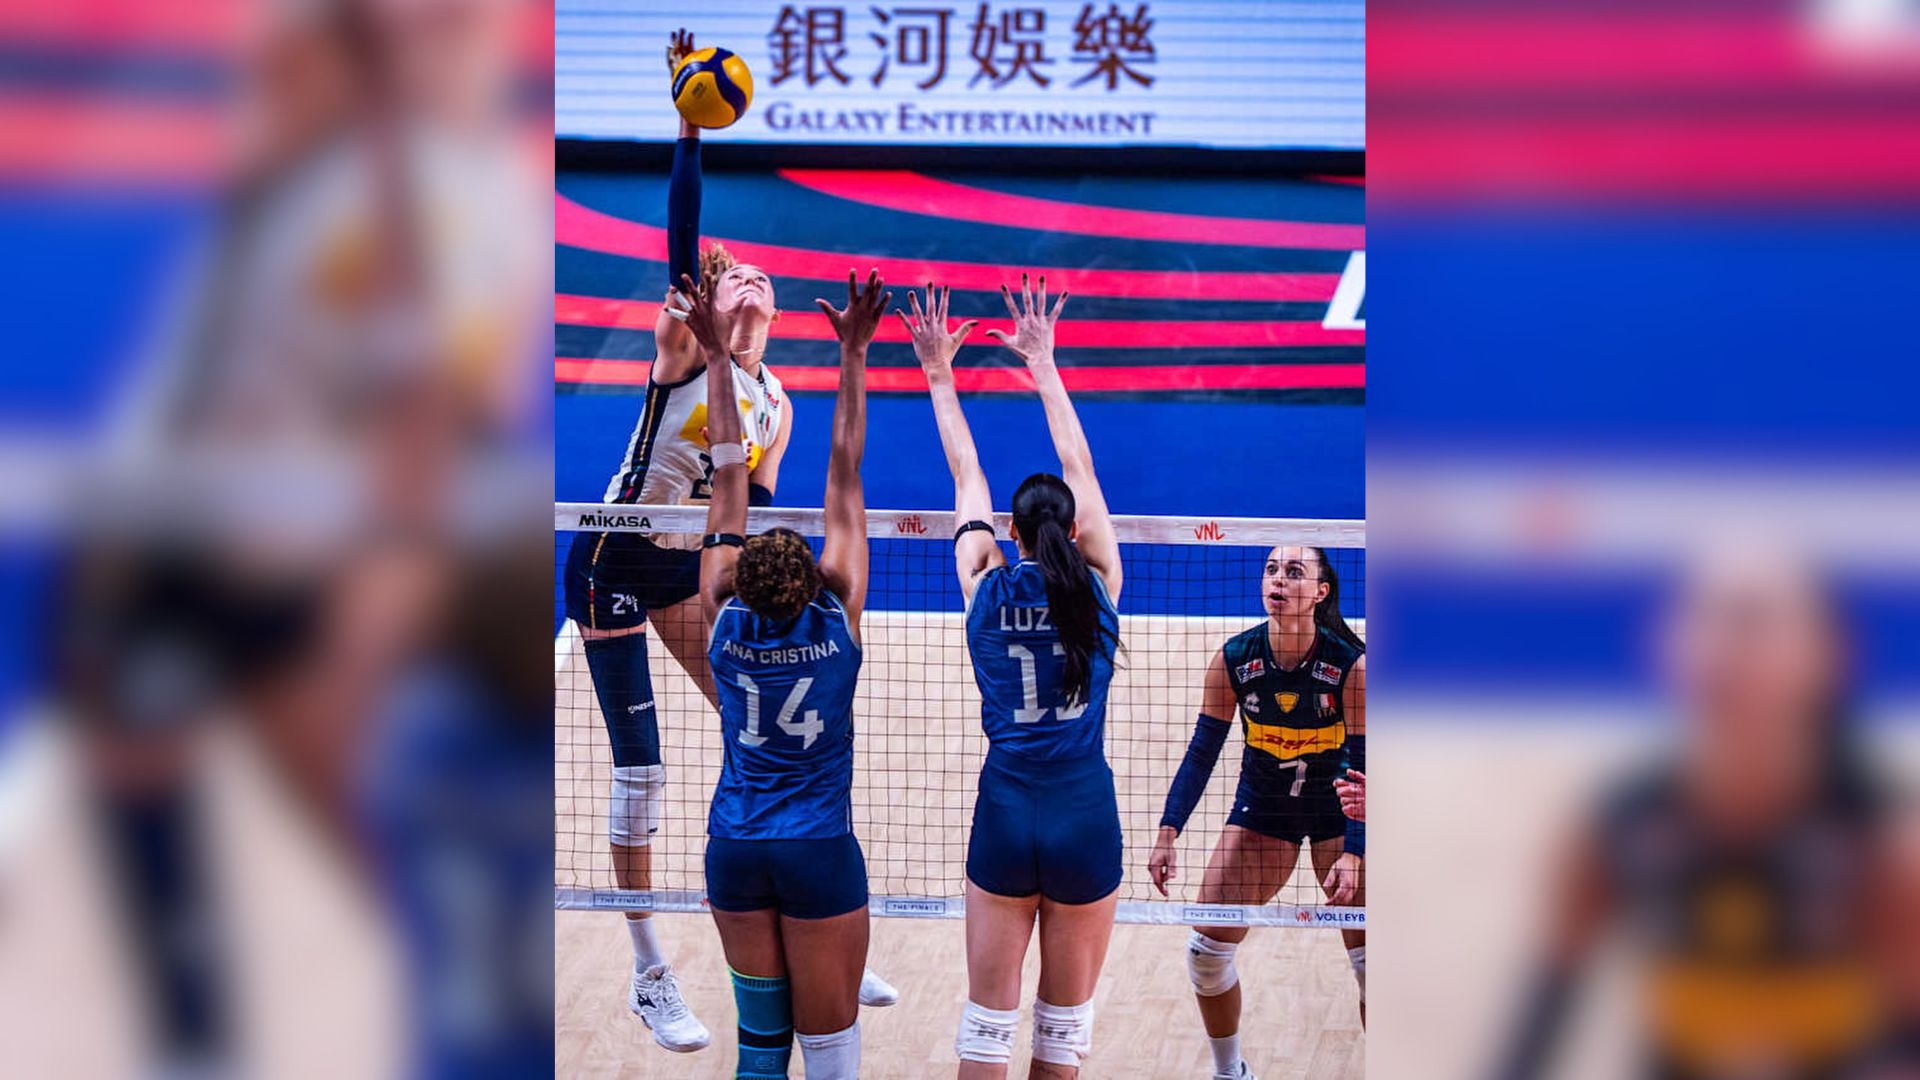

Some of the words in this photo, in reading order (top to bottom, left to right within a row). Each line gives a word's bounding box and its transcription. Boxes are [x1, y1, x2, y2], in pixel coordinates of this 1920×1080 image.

[767, 2, 1156, 90] 銀河娛樂
[896, 514, 928, 535] VNL
[1194, 520, 1226, 541] VNL
[1000, 605, 1058, 632] LUZ
[722, 639, 755, 663] ANA
[759, 639, 840, 665] CRISTINA
[736, 673, 825, 751] 14
[1278, 758, 1308, 797] 7
